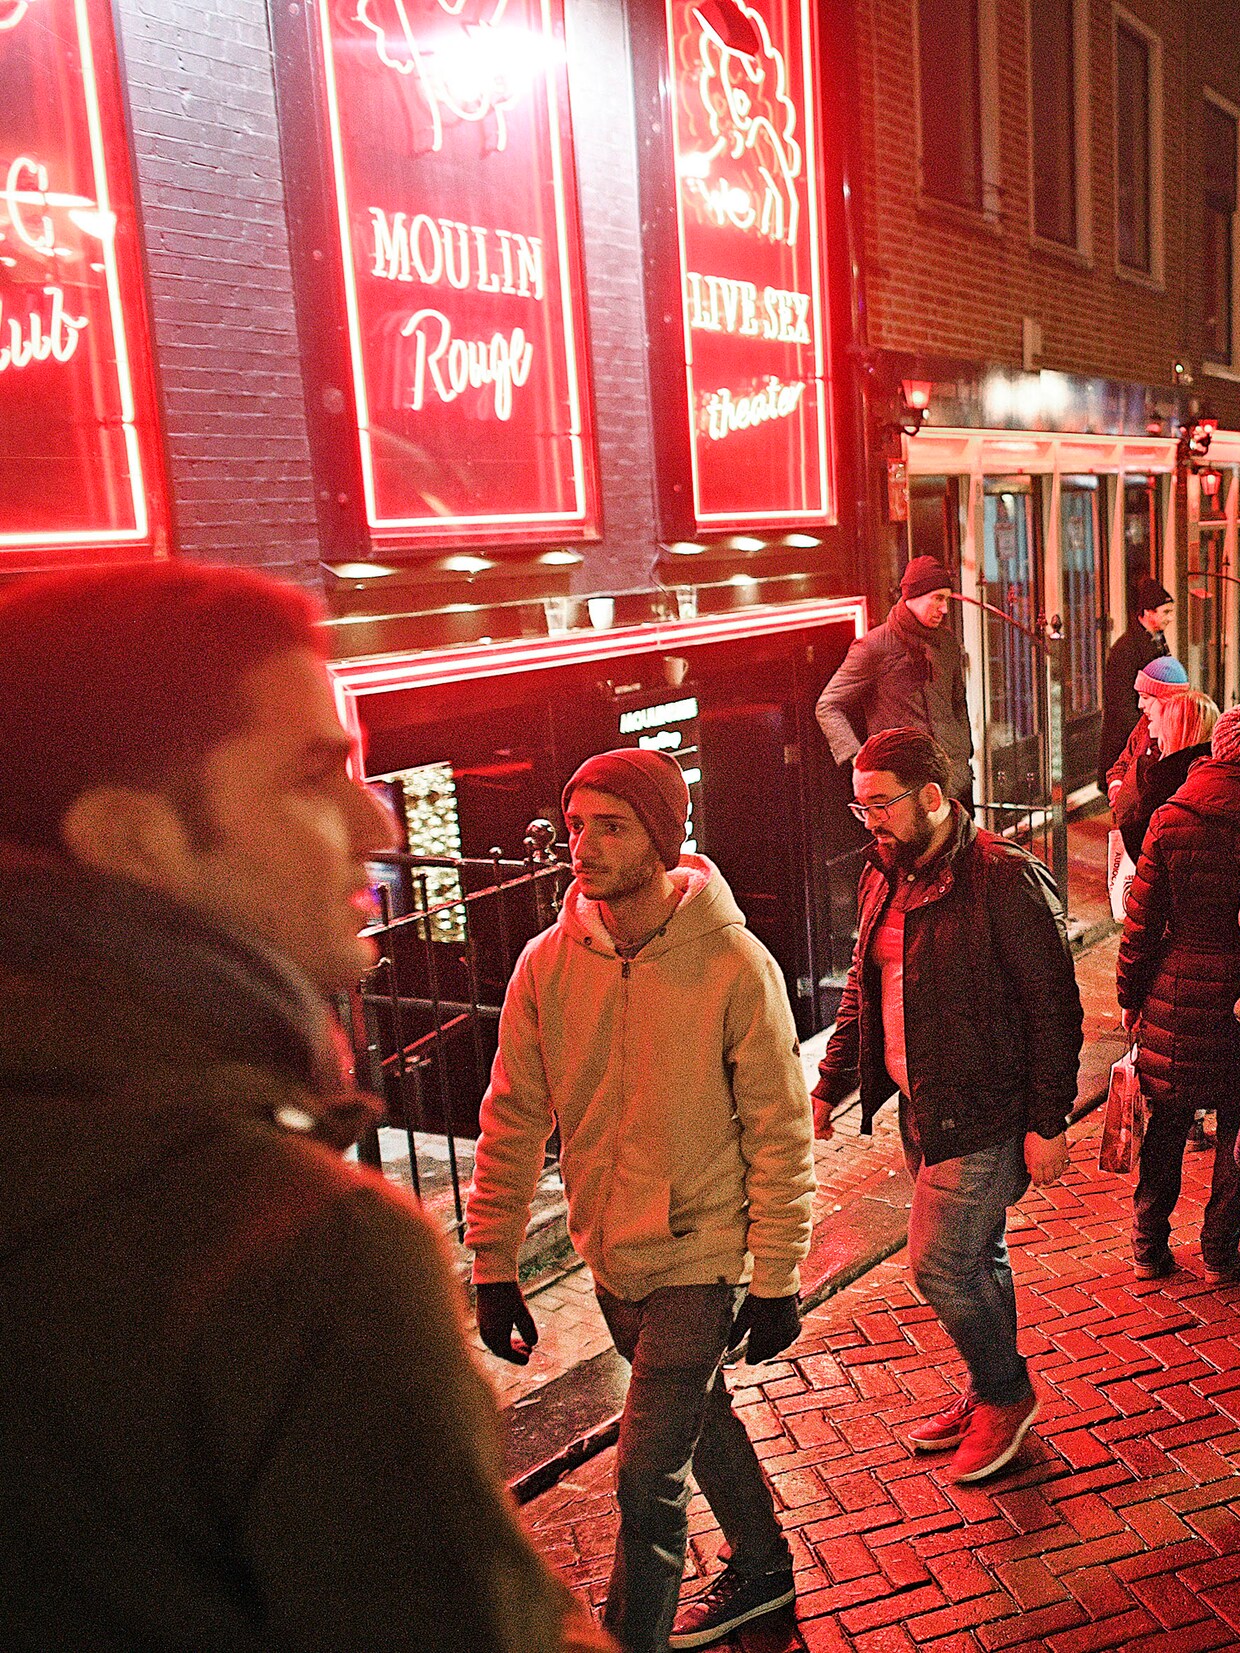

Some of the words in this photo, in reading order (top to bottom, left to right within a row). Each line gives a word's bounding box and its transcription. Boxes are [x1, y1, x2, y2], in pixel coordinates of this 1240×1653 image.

[368, 207, 543, 300] MOULIN
[686, 271, 759, 336] LIVE
[762, 285, 811, 345] SEX
[401, 308, 533, 421] Rouge
